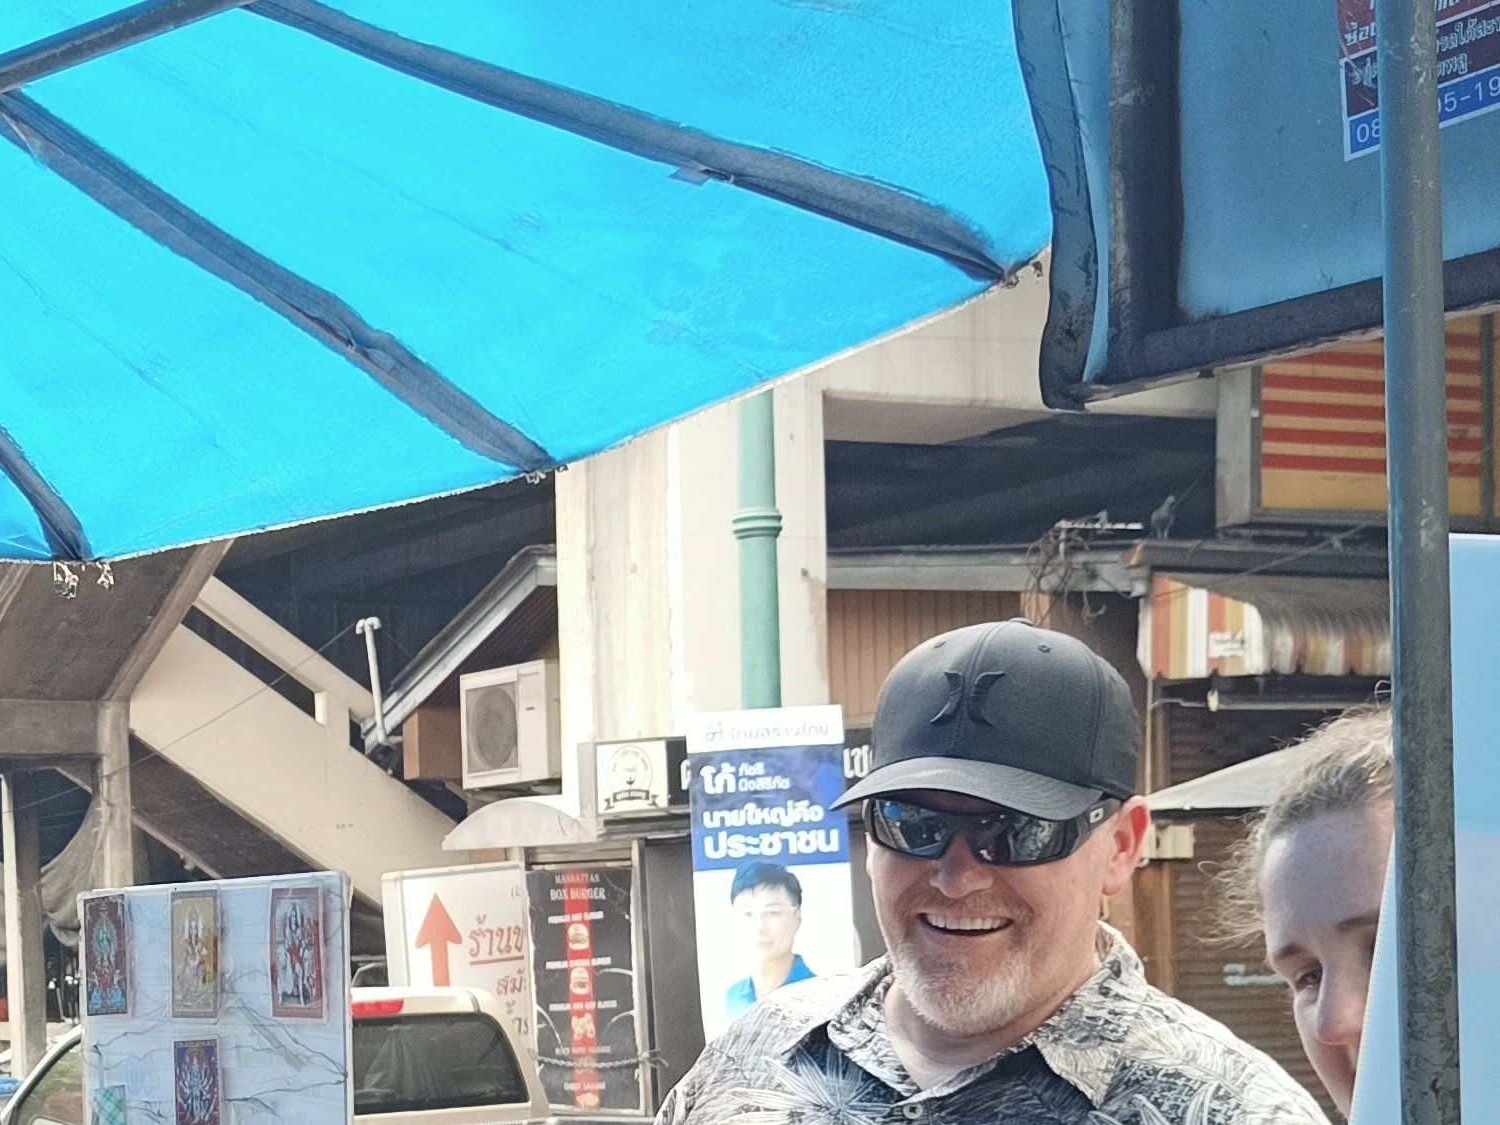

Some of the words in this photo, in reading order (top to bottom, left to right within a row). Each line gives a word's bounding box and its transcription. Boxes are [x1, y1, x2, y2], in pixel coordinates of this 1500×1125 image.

[703, 800, 824, 828] นายใหญ่คือ
[704, 828, 840, 859] ประชาชน
[550, 888, 569, 901] BOX
[570, 888, 606, 900] BURGER
